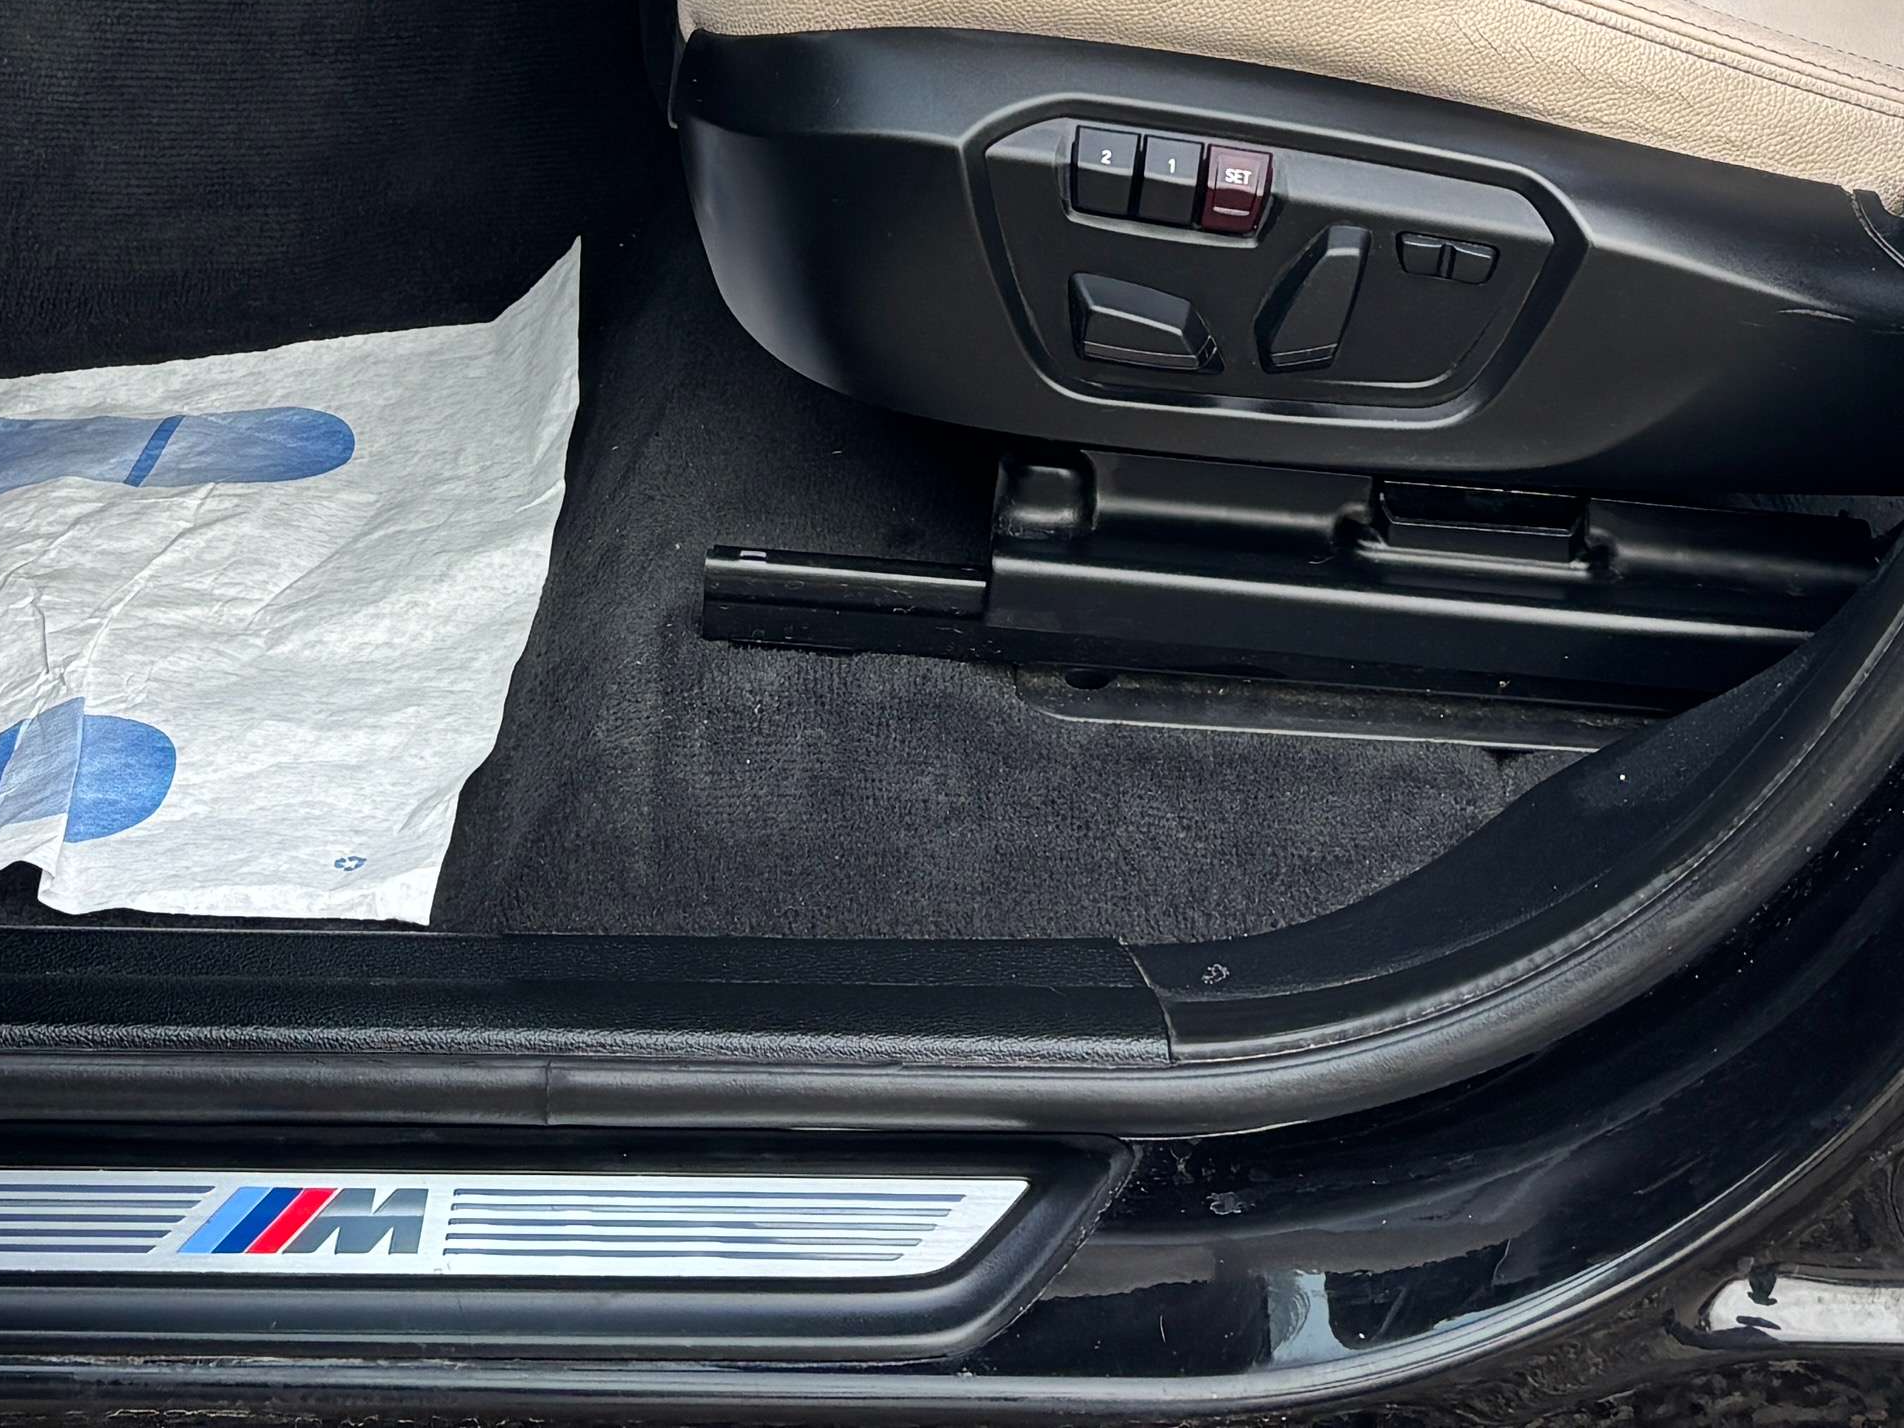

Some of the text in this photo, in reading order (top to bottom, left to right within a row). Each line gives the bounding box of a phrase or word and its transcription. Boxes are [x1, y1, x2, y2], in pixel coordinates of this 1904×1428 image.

[1101, 149, 1252, 185] 2 1 SET
[281, 1187, 429, 1256] M
